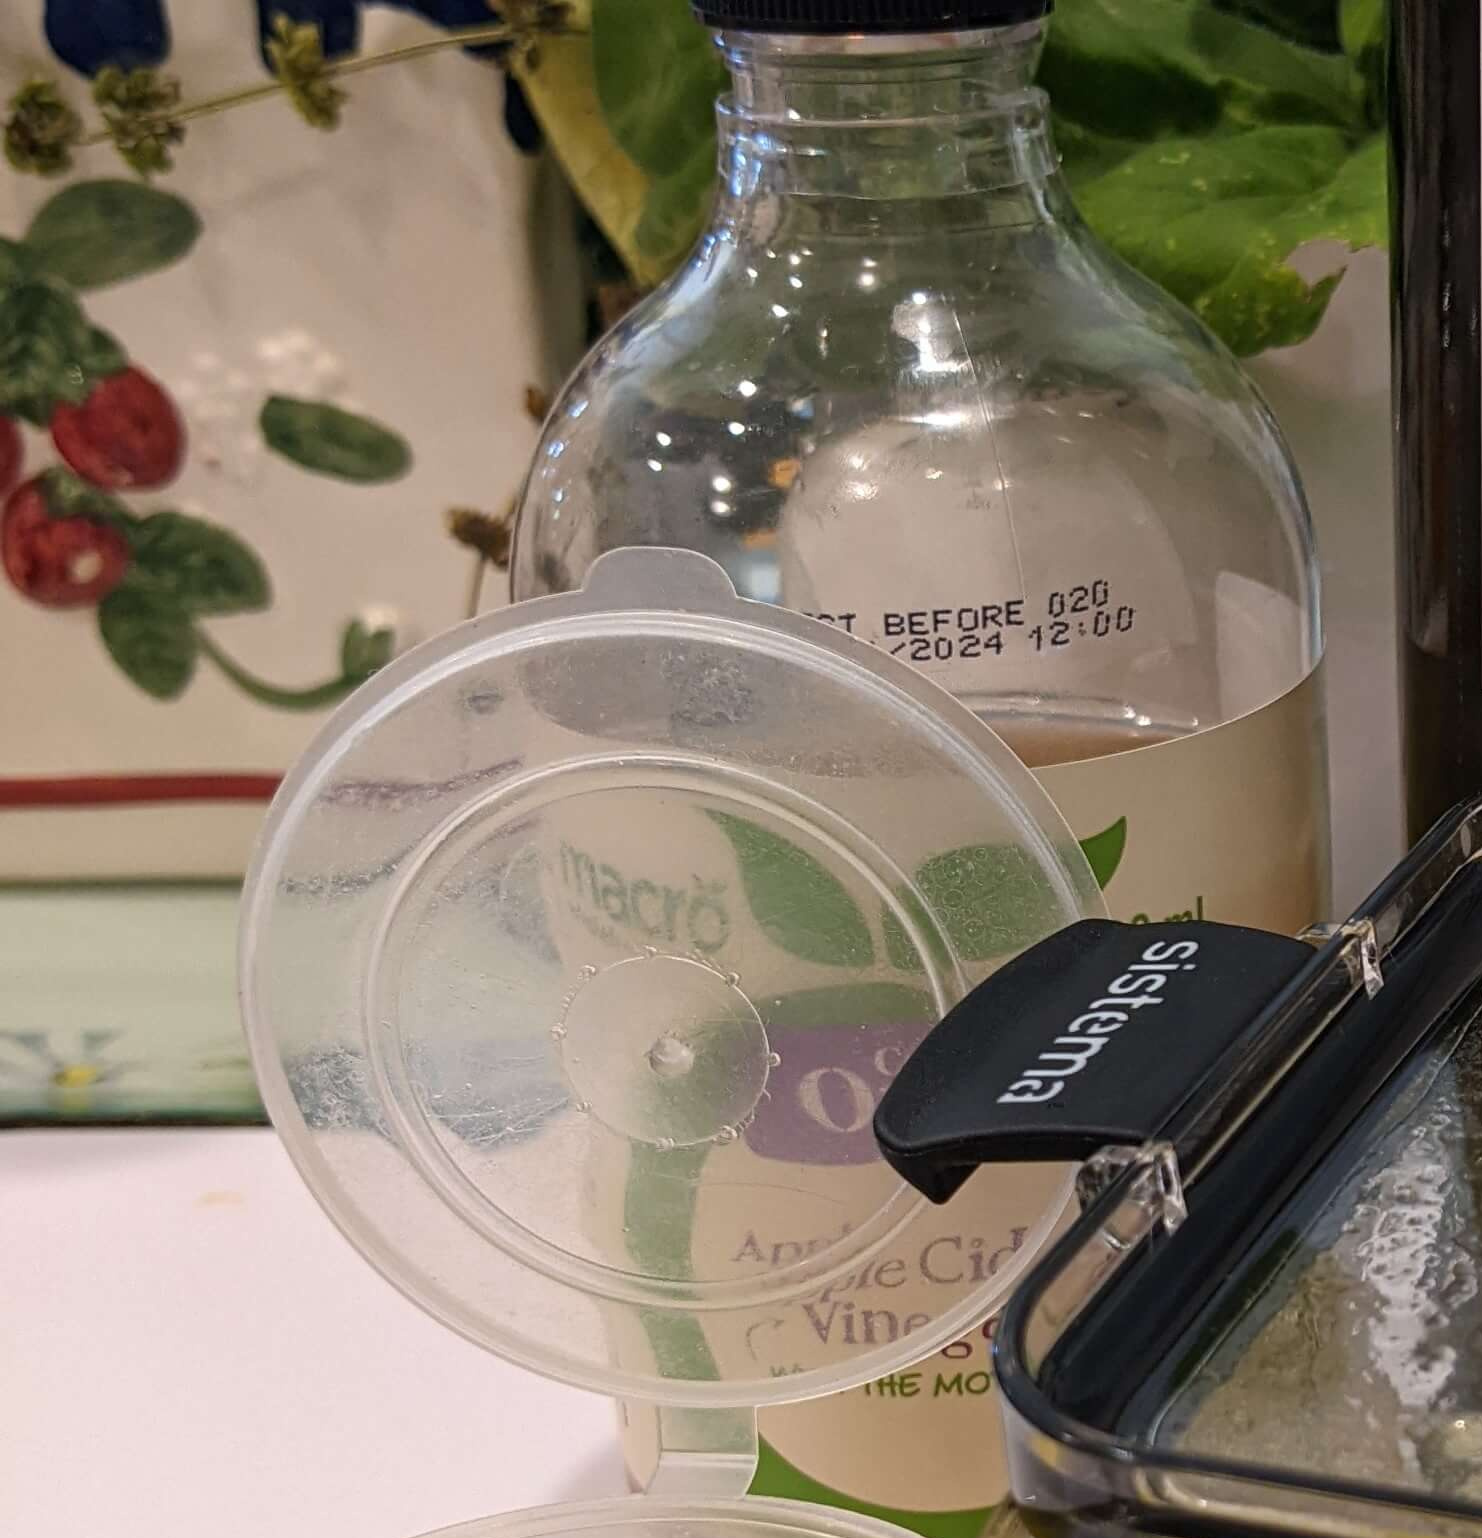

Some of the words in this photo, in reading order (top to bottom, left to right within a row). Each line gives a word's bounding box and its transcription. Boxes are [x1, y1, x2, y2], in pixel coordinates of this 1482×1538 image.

[884, 599, 1025, 637] BEFORE
[1028, 605, 1135, 652] 12:00
[997, 939, 1200, 1104] sistema
